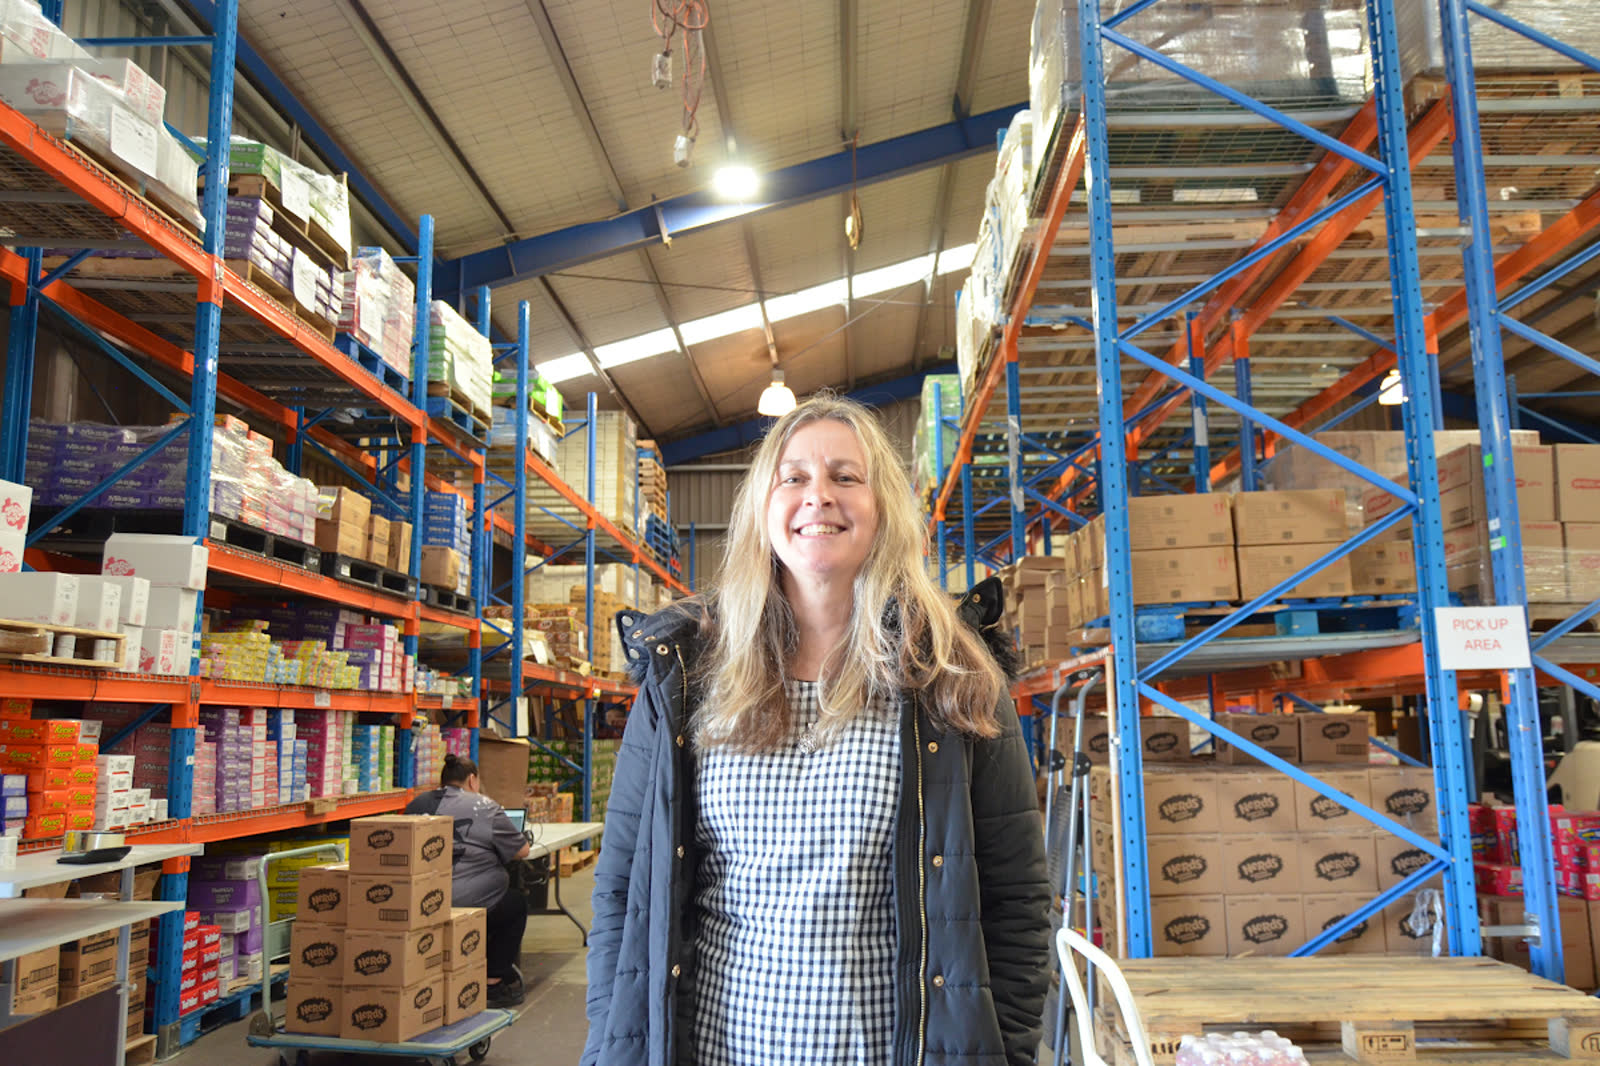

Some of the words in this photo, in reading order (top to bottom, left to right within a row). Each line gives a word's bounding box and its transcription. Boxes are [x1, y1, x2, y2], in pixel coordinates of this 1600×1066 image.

[1453, 618, 1485, 631] PICK
[1488, 618, 1509, 630] UP
[1465, 638, 1501, 651] AREA
